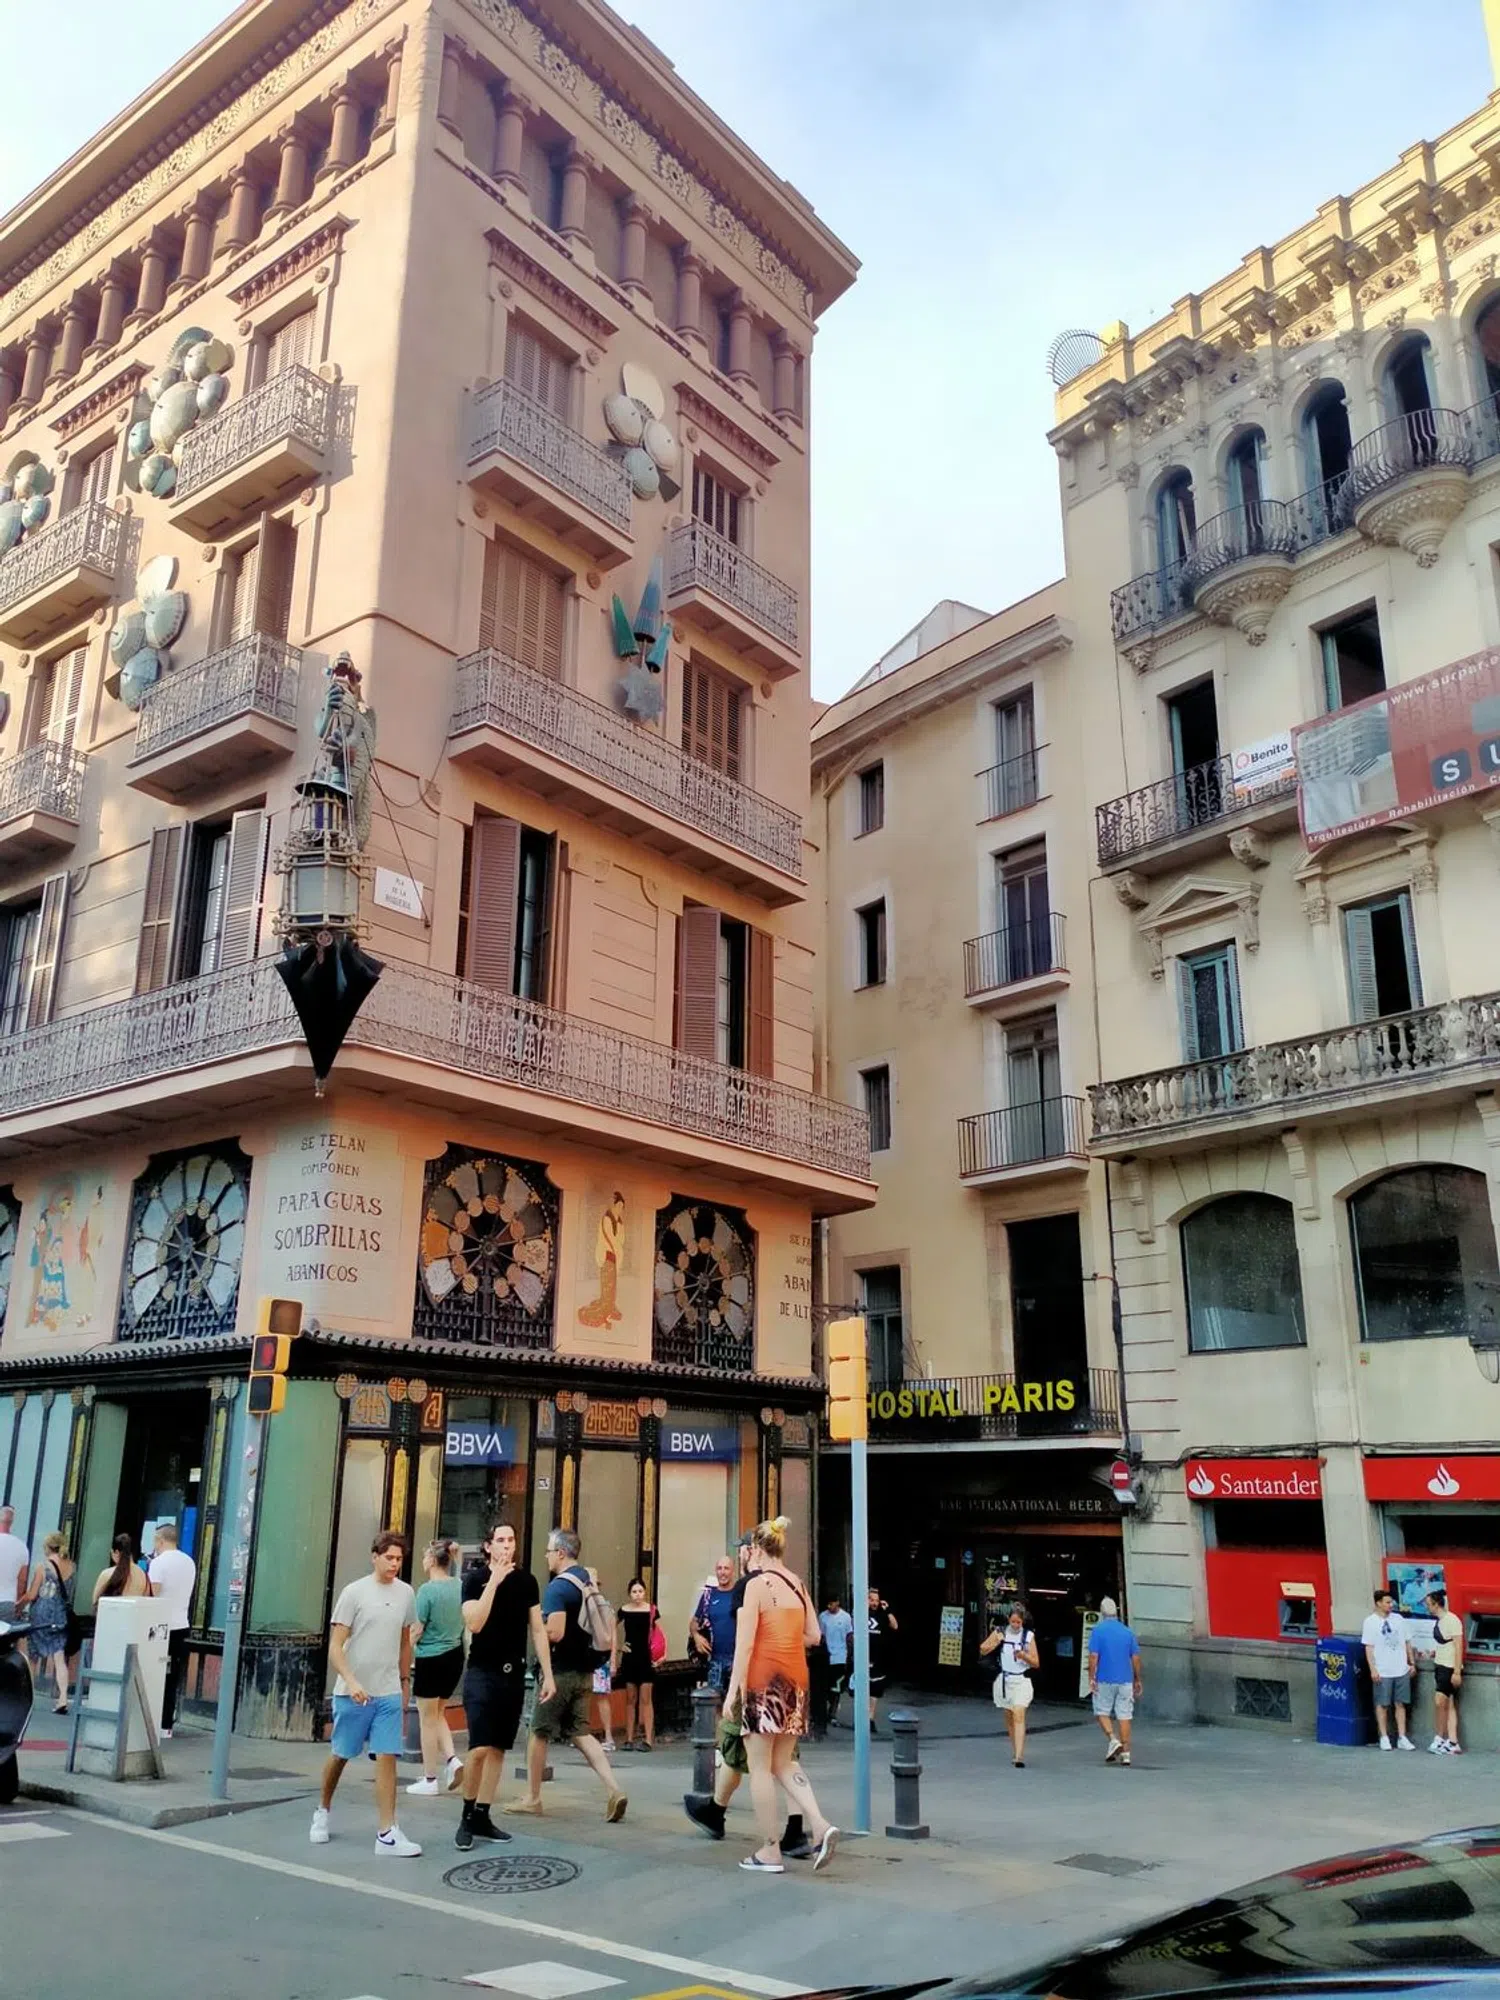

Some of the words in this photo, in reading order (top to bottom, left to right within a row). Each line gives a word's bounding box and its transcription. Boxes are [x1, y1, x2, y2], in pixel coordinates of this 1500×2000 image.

[1251, 744, 1288, 763] Benito
[1307, 818, 1376, 844] Arquitectura
[1389, 784, 1475, 819] Rehabilitación
[301, 1136, 315, 1150] SE
[320, 1134, 366, 1153] TELAN
[325, 1149, 333, 1160] Y
[302, 1162, 360, 1177] COMPONEN
[278, 1190, 383, 1216] PARAGUAS
[274, 1223, 381, 1252] SOMBRILLAS
[286, 1263, 358, 1282] ABANICOS
[780, 1302, 791, 1315] DE
[983, 1380, 1076, 1414] PARIS
[445, 1432, 502, 1455] BBVA
[671, 1433, 714, 1453] BBVA
[1220, 1472, 1319, 1495] Santander
[969, 1500, 1062, 1511] INTERNATIONAL
[1069, 1500, 1102, 1511] BEER
